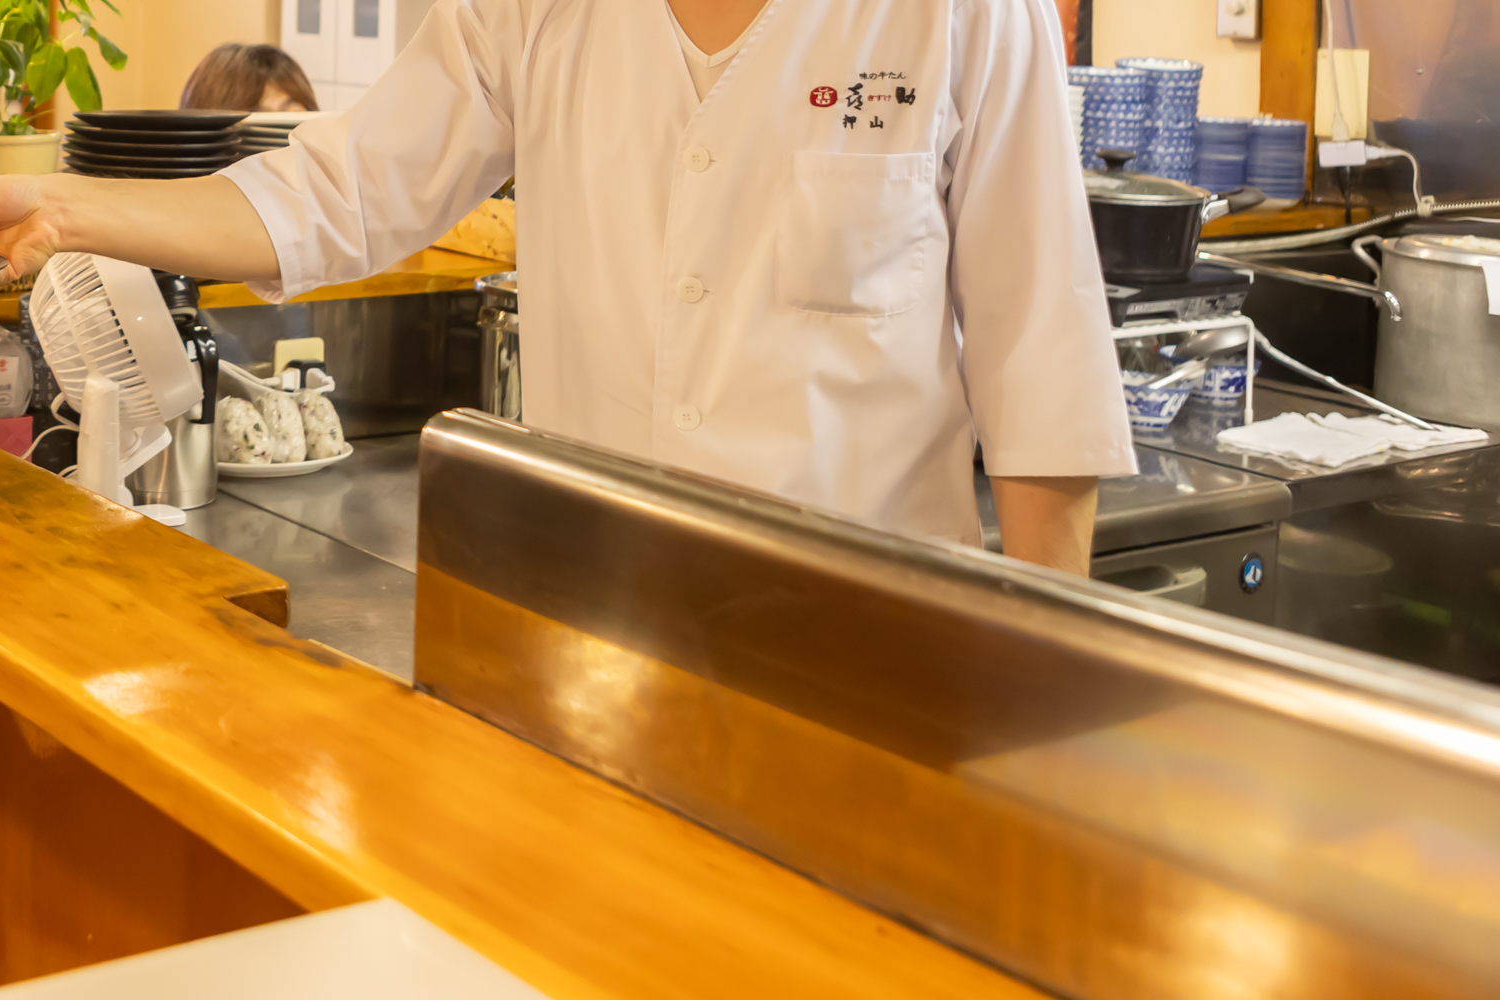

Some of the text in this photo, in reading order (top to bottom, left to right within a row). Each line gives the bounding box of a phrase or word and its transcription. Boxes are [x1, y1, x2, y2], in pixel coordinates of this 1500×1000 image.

[858, 71, 907, 80] 味の牛たん
[867, 93, 892, 102] きすけ
